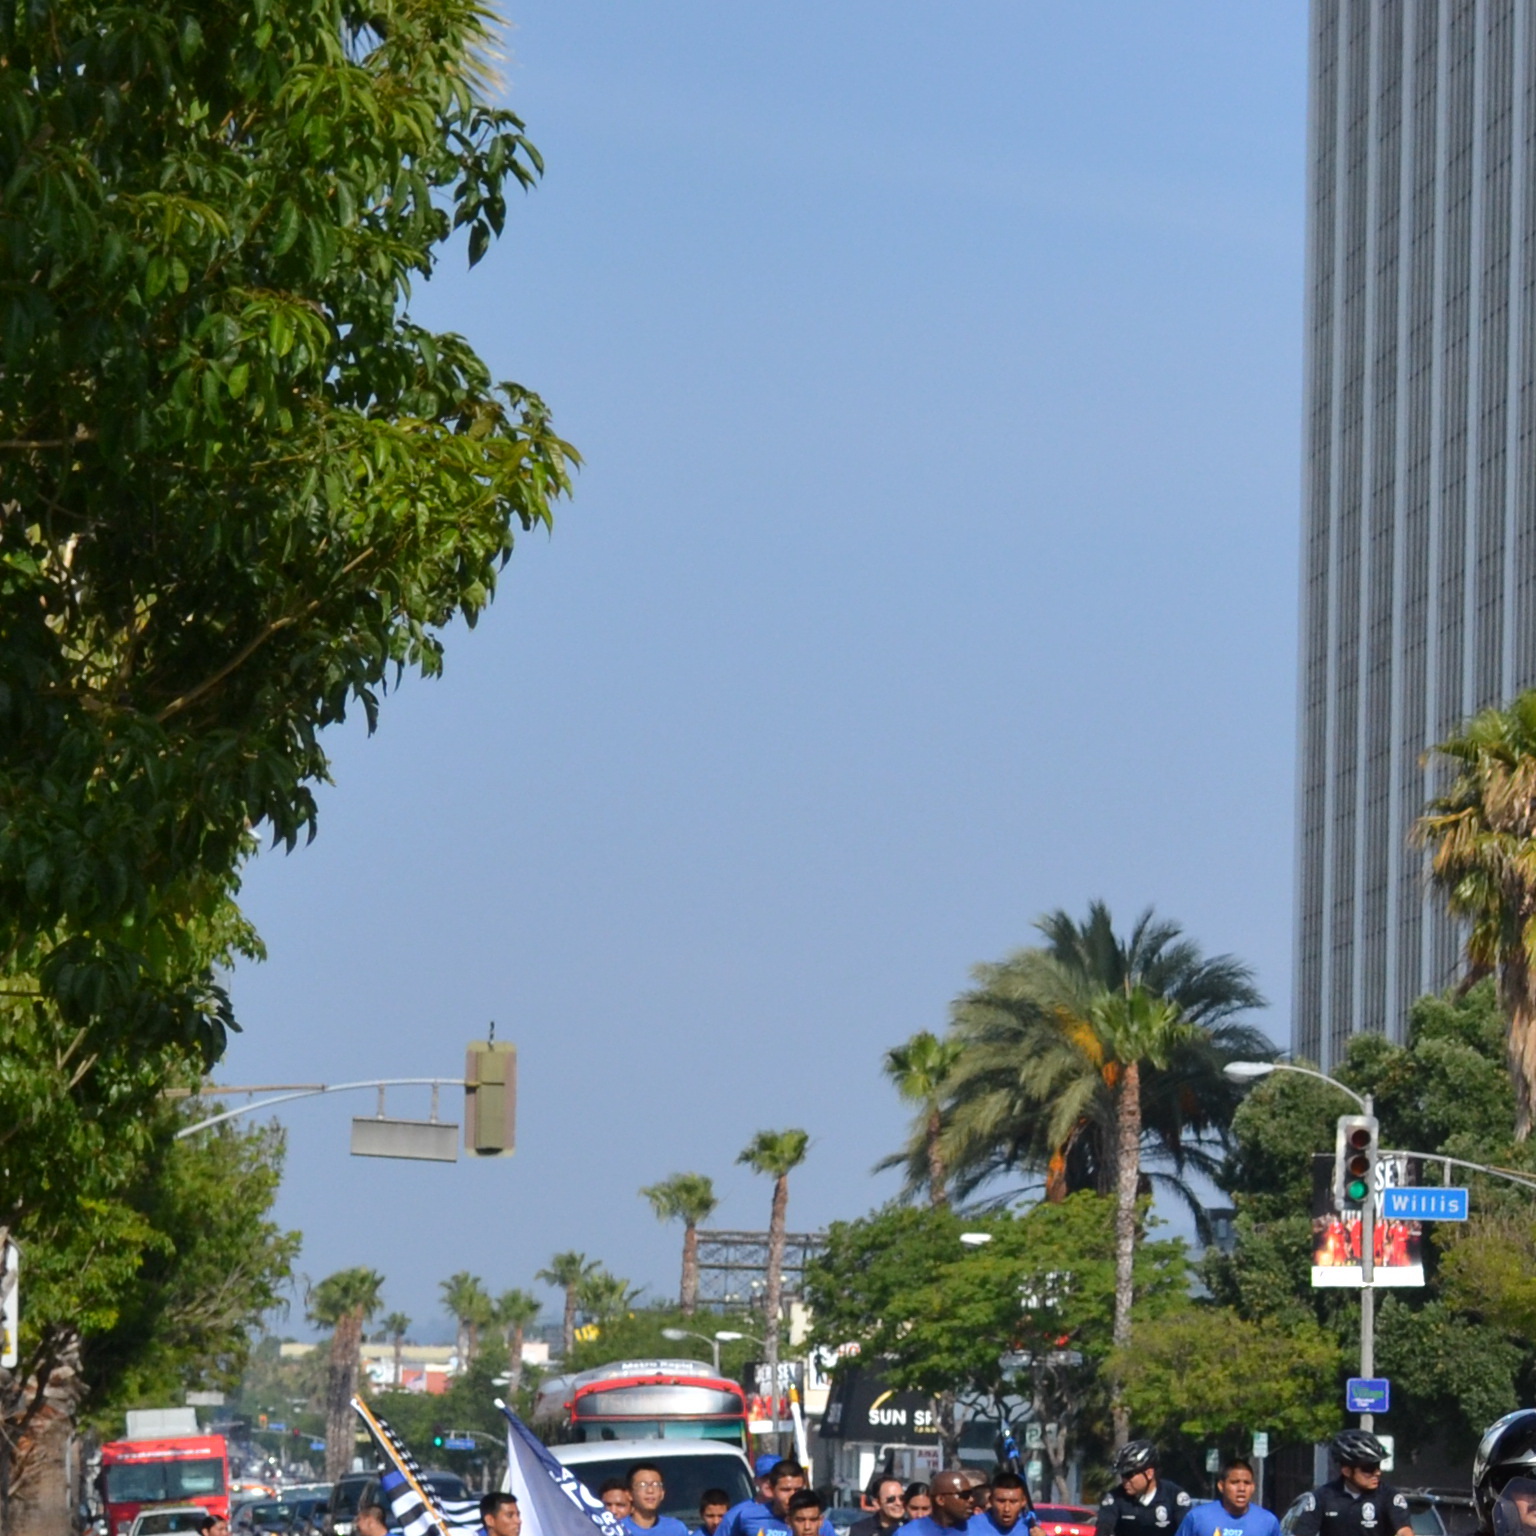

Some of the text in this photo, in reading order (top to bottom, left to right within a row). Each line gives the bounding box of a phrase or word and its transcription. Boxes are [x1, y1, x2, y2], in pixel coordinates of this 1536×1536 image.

[1392, 1195, 1459, 1213] Willis
[622, 1361, 693, 1370] Metro Rapid
[868, 1408, 907, 1426] SUN
[1223, 1528, 1243, 1536] 2017
